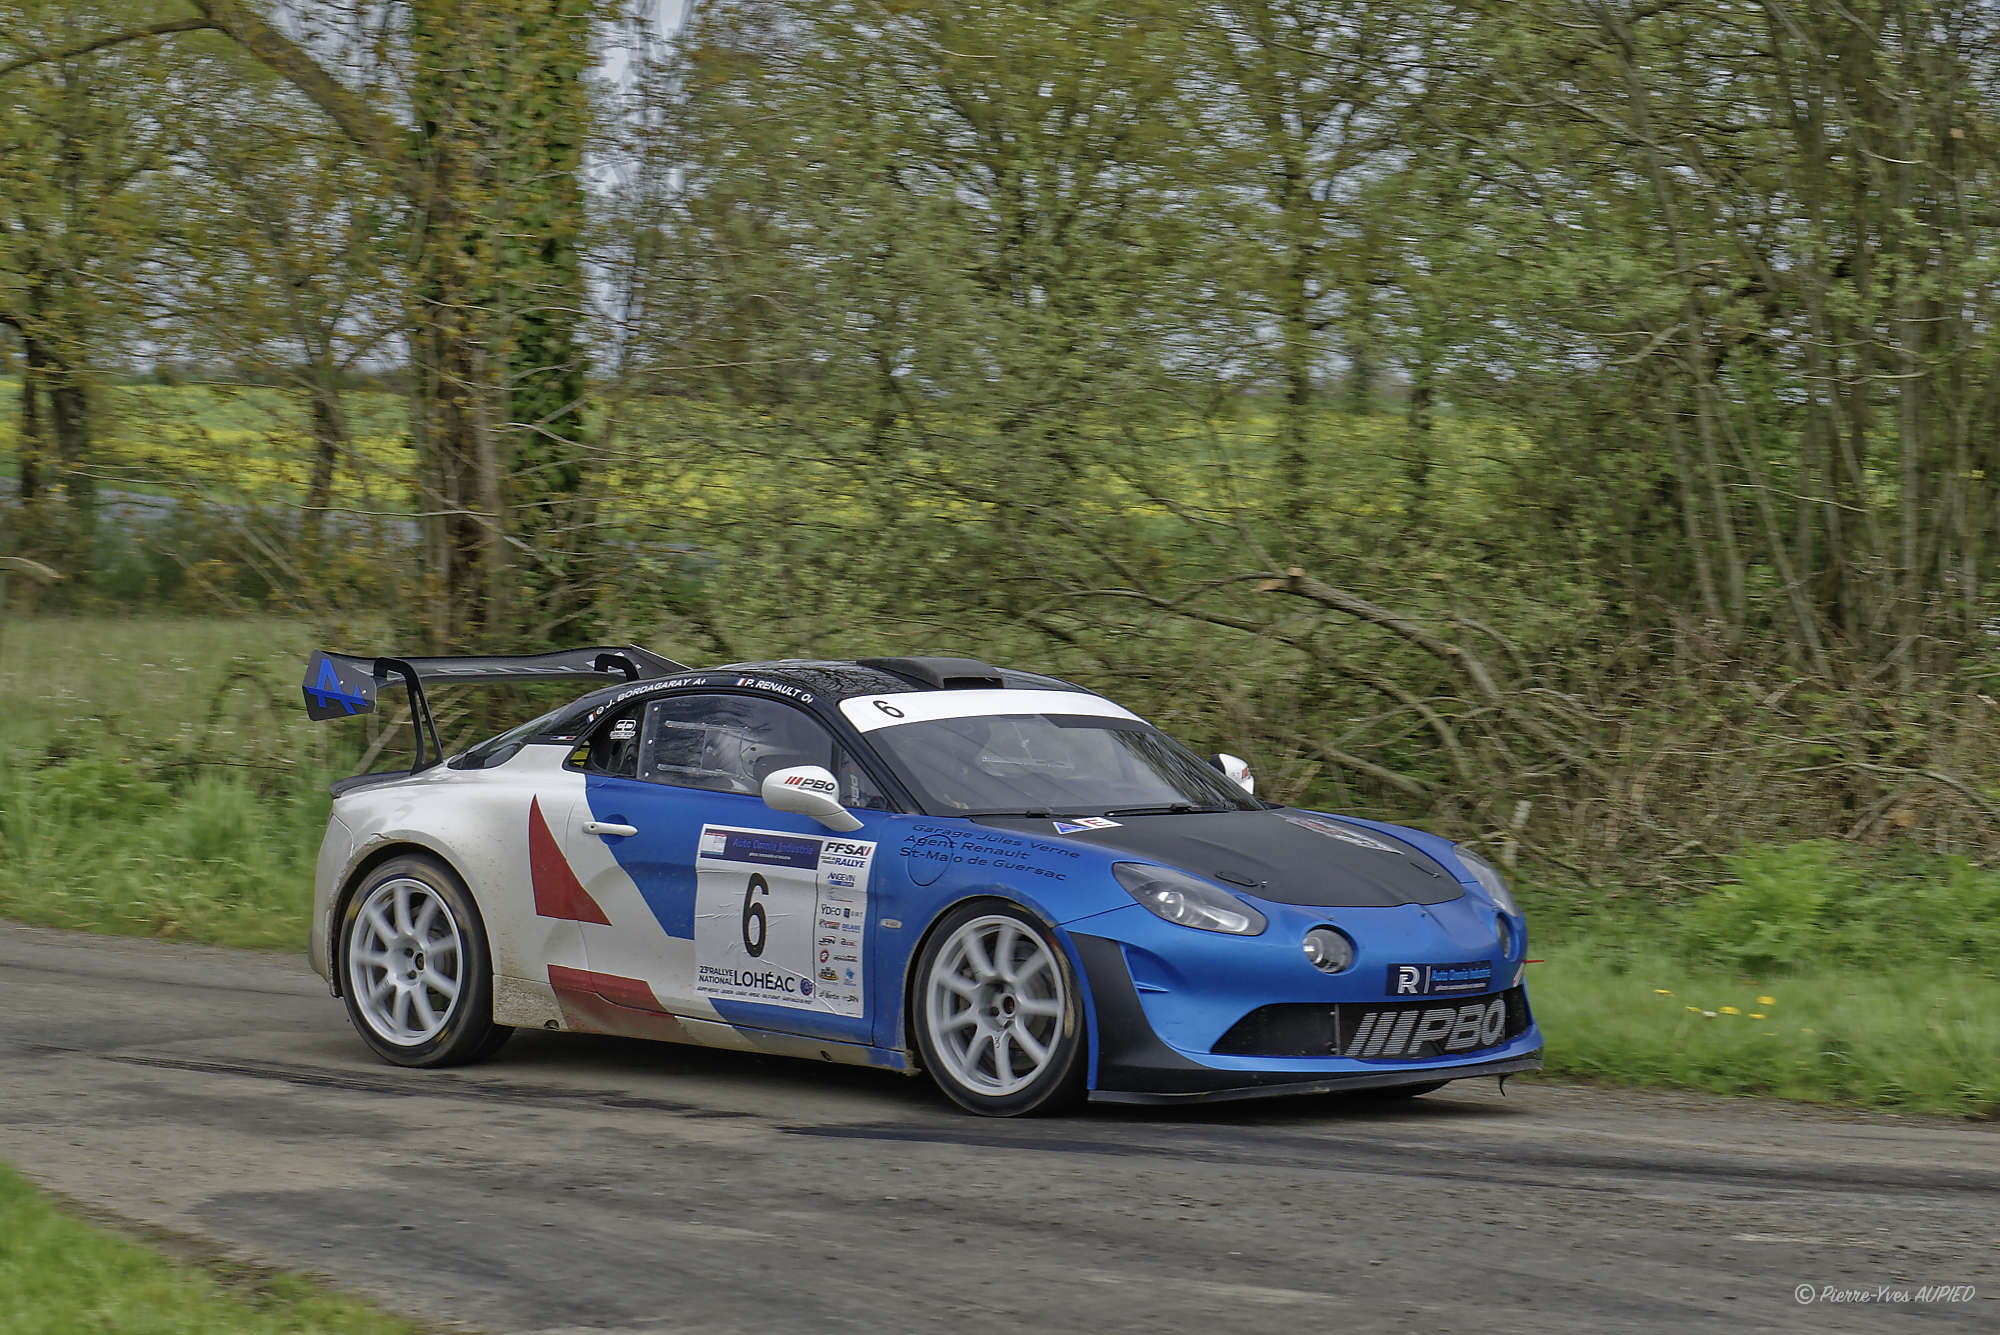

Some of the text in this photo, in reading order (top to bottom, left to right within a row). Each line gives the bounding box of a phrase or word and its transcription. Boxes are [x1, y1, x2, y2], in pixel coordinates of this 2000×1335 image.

[617, 678, 691, 702] BORDAGARAY
[744, 679, 754, 688] P.
[755, 680, 802, 697] RENAULT
[872, 700, 905, 719] 6
[801, 778, 836, 792] PBO
[825, 842, 865, 856] FFSA
[904, 834, 1031, 861] Agent Renault
[912, 823, 1081, 859] Garage Jules Verne
[834, 858, 867, 869] RALLYE
[900, 847, 1068, 881] St-Malo de Guersac
[742, 872, 770, 958] 6
[699, 974, 734, 986] NATIONAL
[709, 966, 735, 977] RALLYE
[733, 970, 796, 993] LOHÉAC
[1407, 999, 1506, 1056] PBO
